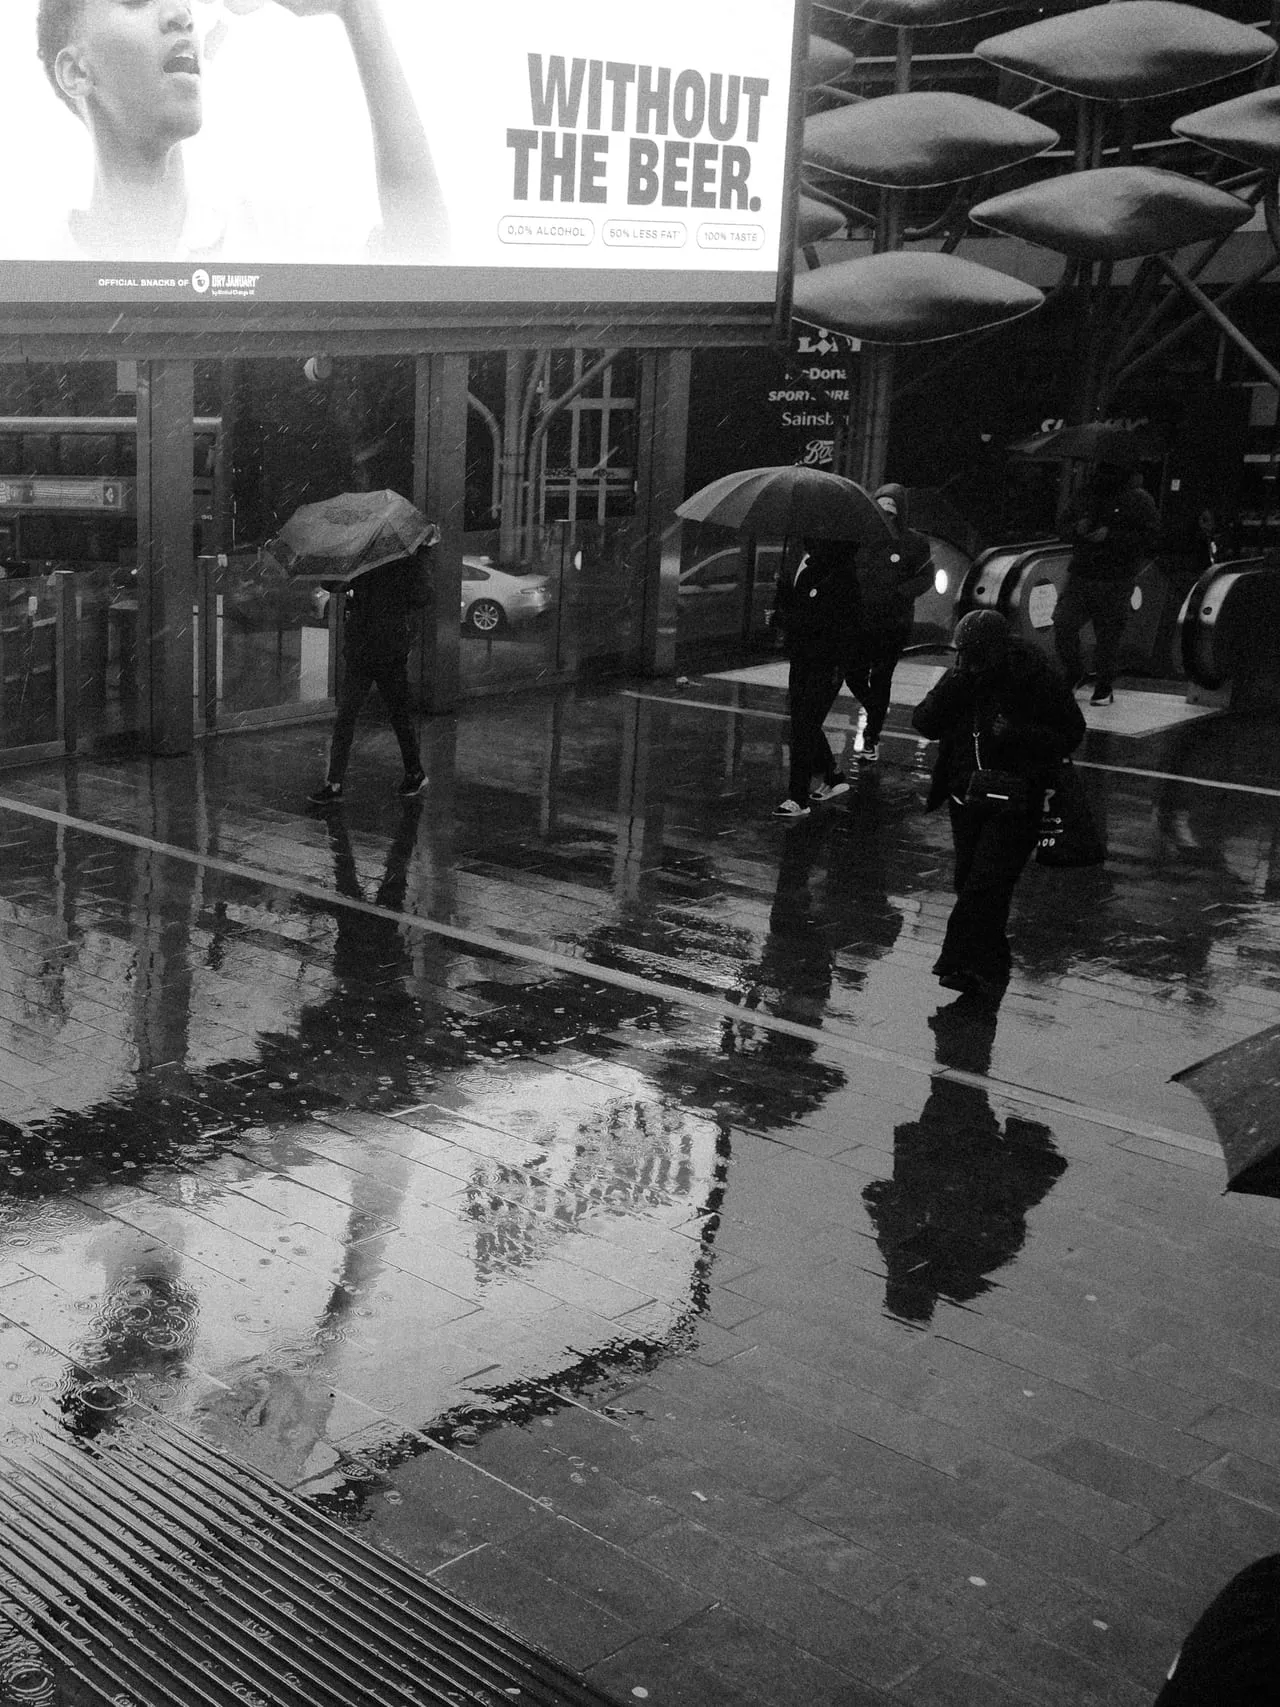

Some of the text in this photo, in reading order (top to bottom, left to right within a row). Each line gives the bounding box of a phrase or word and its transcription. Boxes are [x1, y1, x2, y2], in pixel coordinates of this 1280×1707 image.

[527, 52, 770, 143] WITHOUT
[506, 128, 762, 212] THE BEER.
[536, 225, 586, 237] ALCOHOL
[609, 229, 630, 239] 50%
[632, 229, 658, 239] LESS
[704, 231, 758, 242] 100% TASTE
[98, 278, 190, 287] OFFICIAL SNACKS OF
[211, 274, 225, 287] DRY
